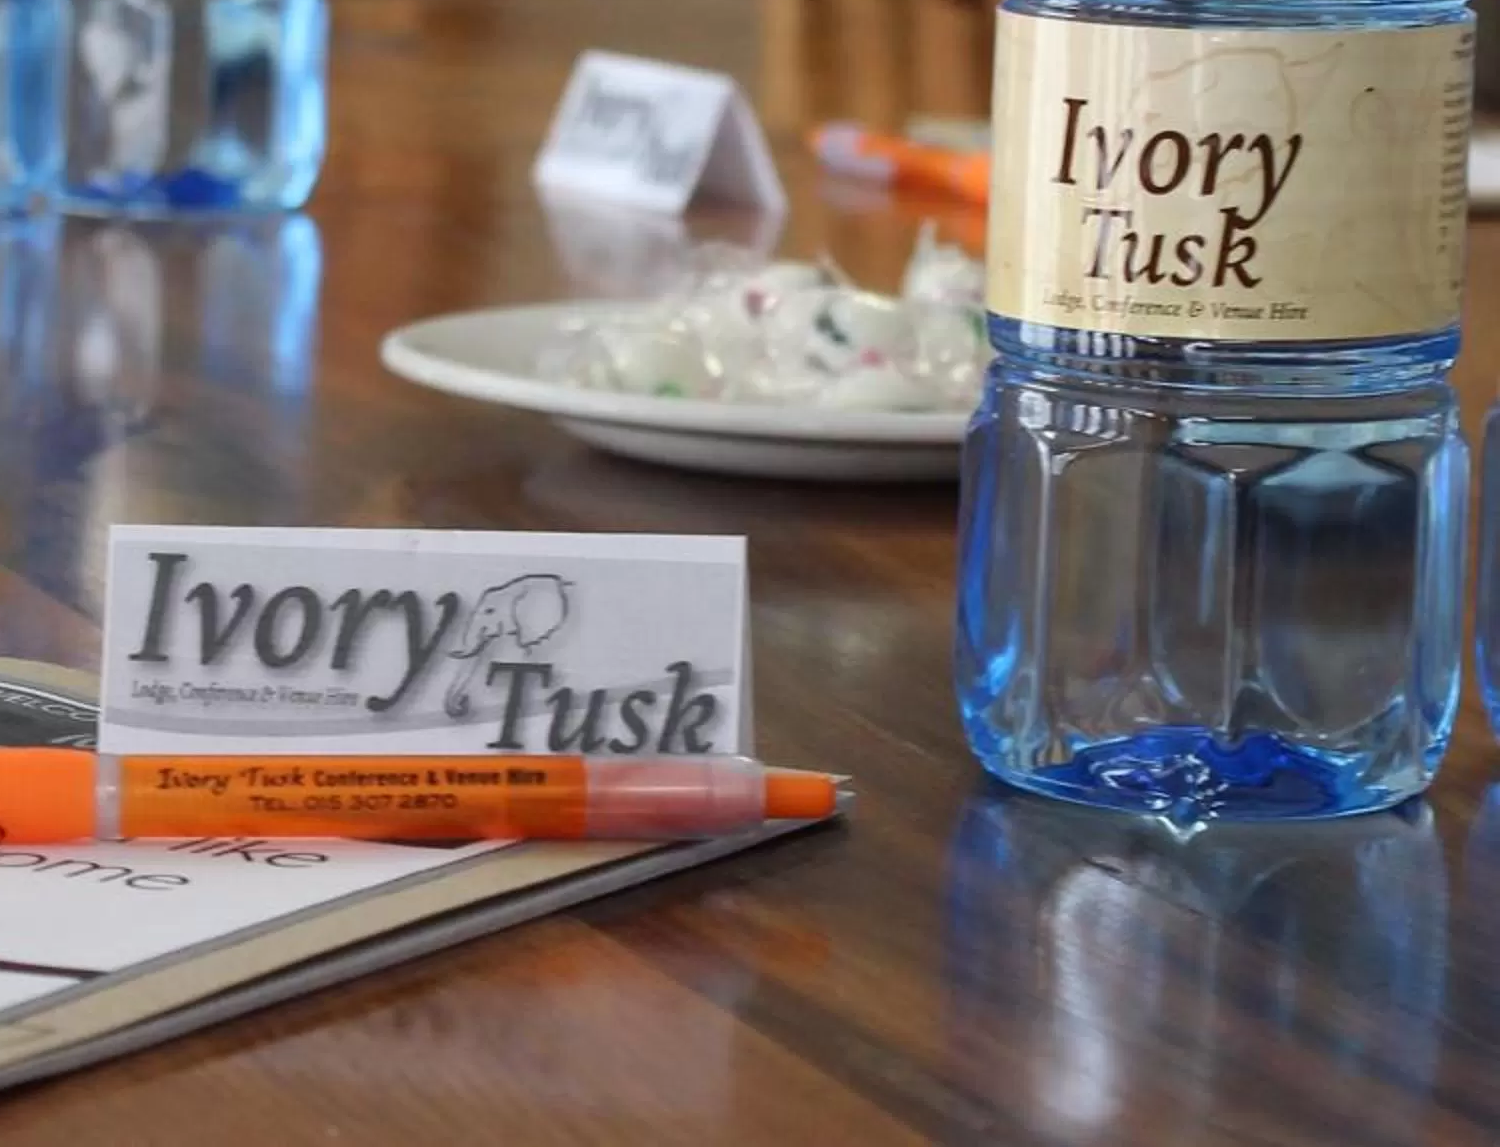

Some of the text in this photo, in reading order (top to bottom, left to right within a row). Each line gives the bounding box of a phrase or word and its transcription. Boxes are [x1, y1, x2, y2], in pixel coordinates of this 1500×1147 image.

[1051, 97, 1303, 229] Ivory
[1081, 207, 1263, 288] Tusk
[1187, 300, 1205, 318] &
[1268, 302, 1309, 320] Hire
[128, 551, 461, 713] Ivory
[485, 659, 720, 753] Tusk
[155, 765, 547, 796] Ivory Tusk Conference & Venue Hire
